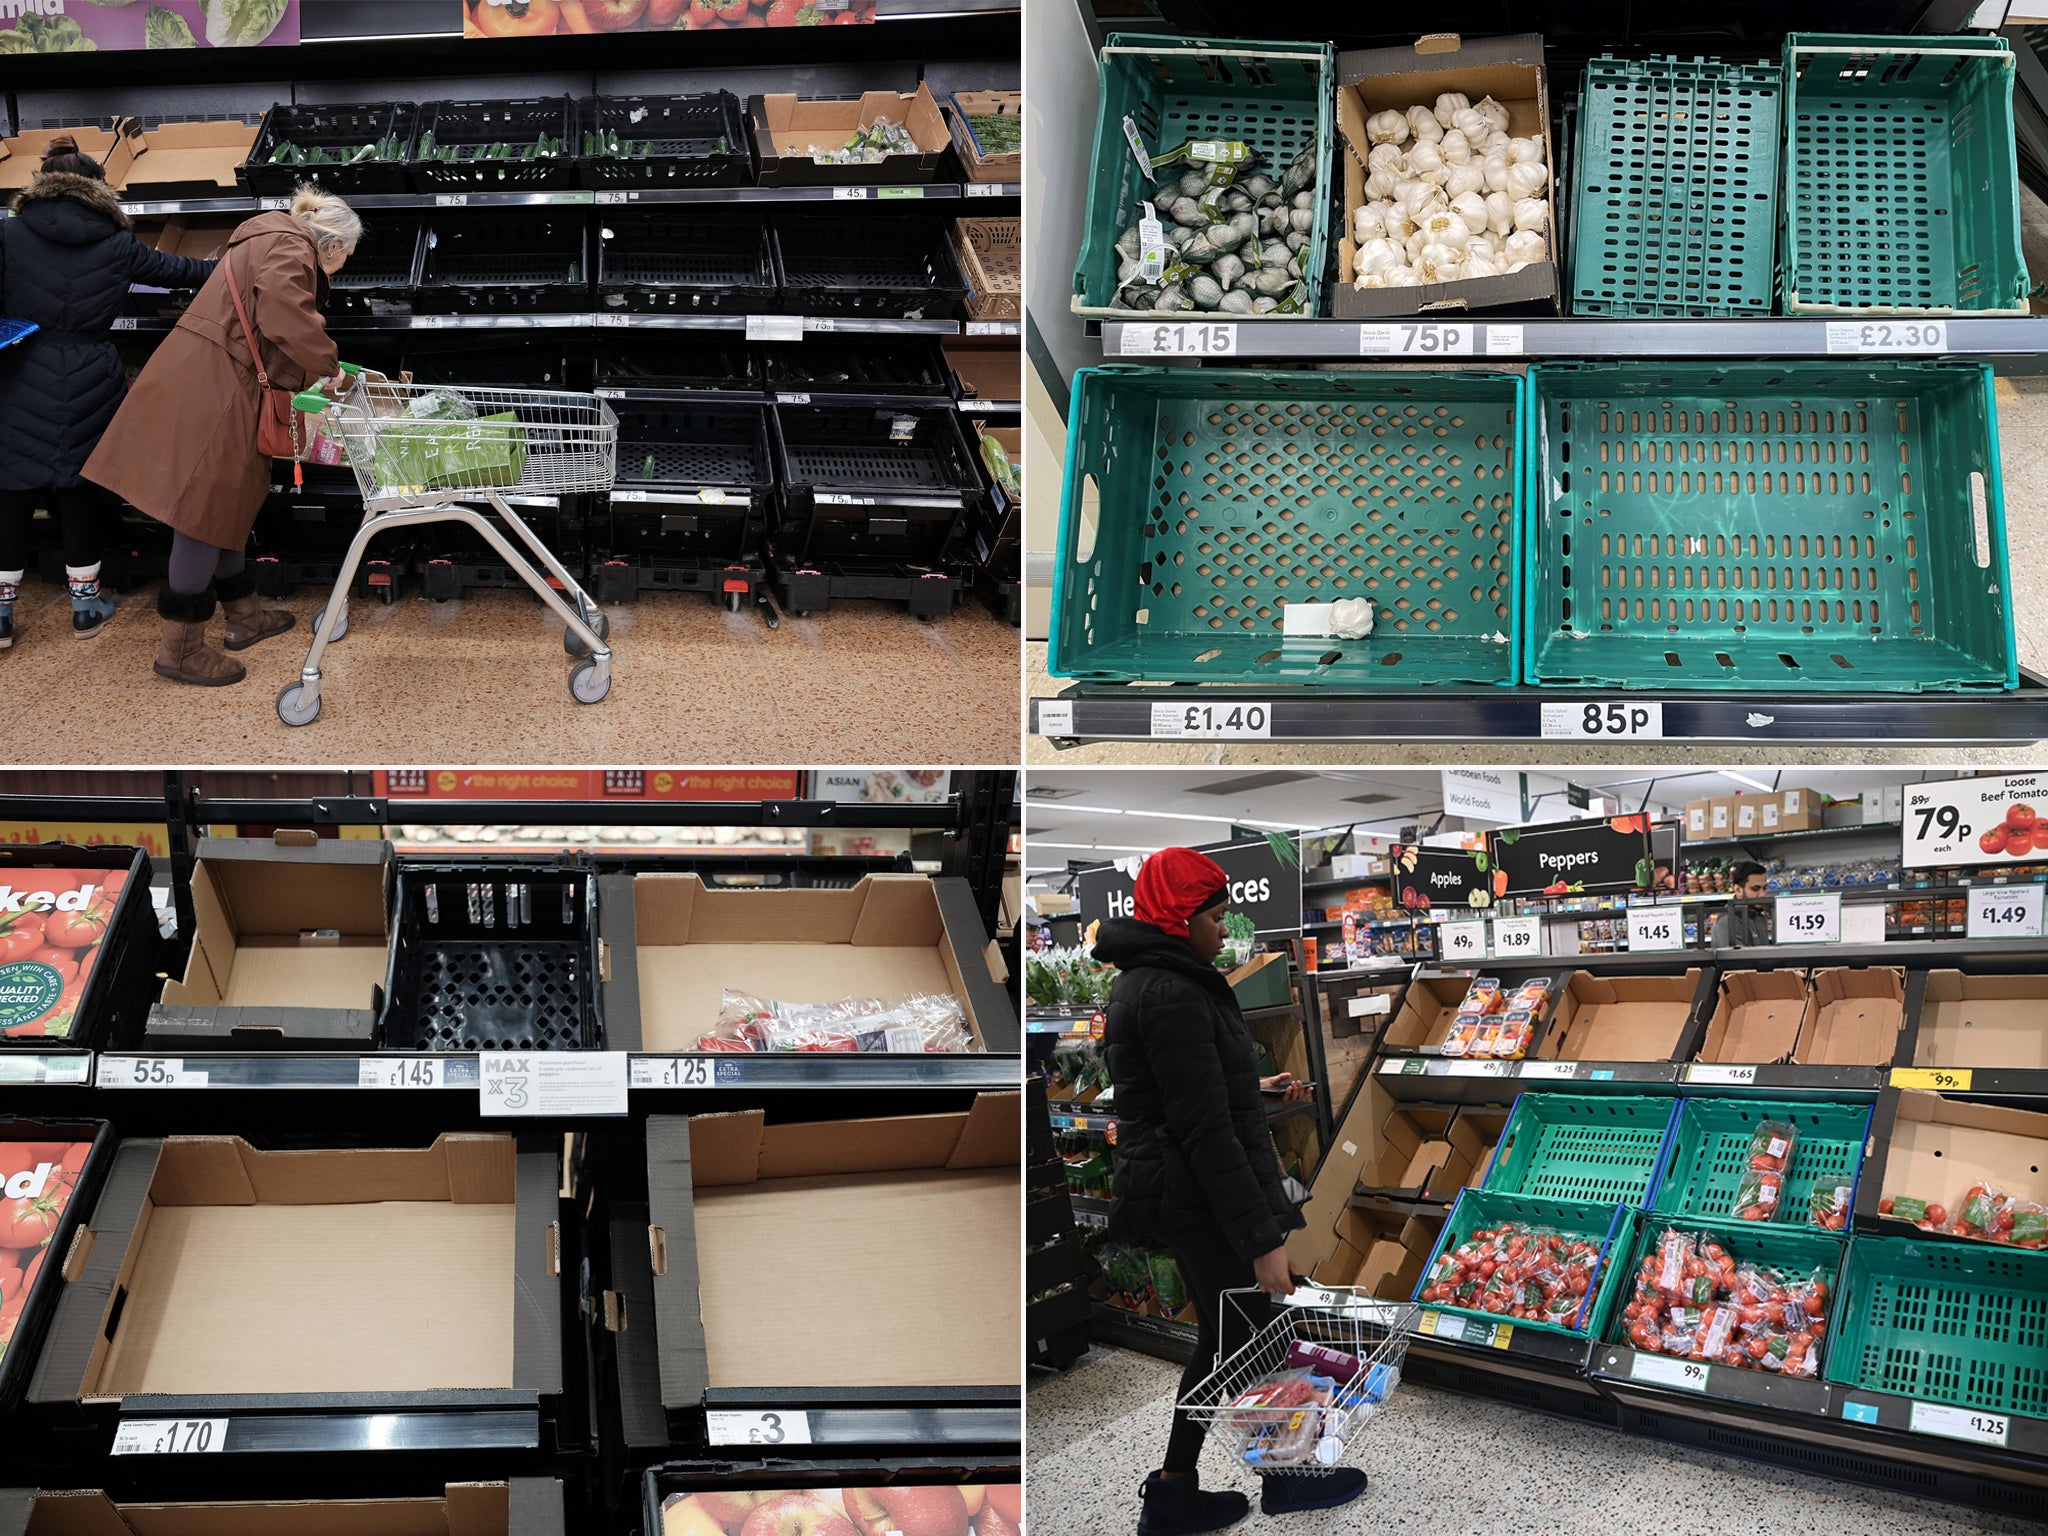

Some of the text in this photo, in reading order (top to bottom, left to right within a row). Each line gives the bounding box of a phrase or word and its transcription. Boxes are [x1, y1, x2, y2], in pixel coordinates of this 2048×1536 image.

[846, 188, 863, 198] 45p
[980, 184, 993, 196] £1
[274, 200, 288, 209] 75p
[450, 196, 464, 206] 75p
[608, 193, 624, 203] 75p
[610, 316, 626, 326] 75p
[815, 320, 830, 330] 75p
[1153, 326, 1230, 352] £1.15
[1401, 325, 1460, 352] 75p
[1860, 326, 1940, 346] £2.30
[625, 491, 642, 500] 75p
[830, 494, 848, 504] 75p
[1184, 706, 1265, 731] £1.40
[1582, 704, 1648, 734] 85p
[474, 775, 578, 788] the right choice
[690, 776, 792, 791] the right choice
[826, 776, 860, 787] ASIAN
[1482, 772, 1501, 784] Foods
[2004, 778, 2036, 787] Loose
[1449, 792, 1491, 809] World Foods
[1981, 792, 2005, 802] Beef
[1914, 805, 1972, 843] 79p
[1539, 851, 1599, 871] Peppers
[1430, 871, 1462, 888] Apples
[1983, 906, 2026, 923] £1.49
[1789, 914, 1825, 930] £1.59
[1639, 925, 1670, 940] £1.45
[1454, 935, 1473, 948] 49p
[1503, 933, 1530, 947] £1.89
[22, 965, 44, 974] WITH
[44, 971, 58, 988] CARE
[16, 1011, 38, 1024] AND
[38, 992, 57, 1012] TASTE
[134, 1060, 174, 1086] 55p
[390, 1060, 433, 1086] £1.45
[485, 1059, 530, 1073] MAX
[664, 1058, 706, 1084] £1.25
[1483, 1063, 1497, 1072] 49p
[1555, 1065, 1574, 1073] £1.25
[1729, 1069, 1752, 1079] £1.65
[1936, 1075, 1959, 1087] 99p
[1320, 1292, 1332, 1304] 49p
[1685, 1365, 1704, 1381] 99p
[749, 1413, 785, 1444] £3
[1970, 1416, 2004, 1435] £1.25
[154, 1422, 212, 1452] £1.70
